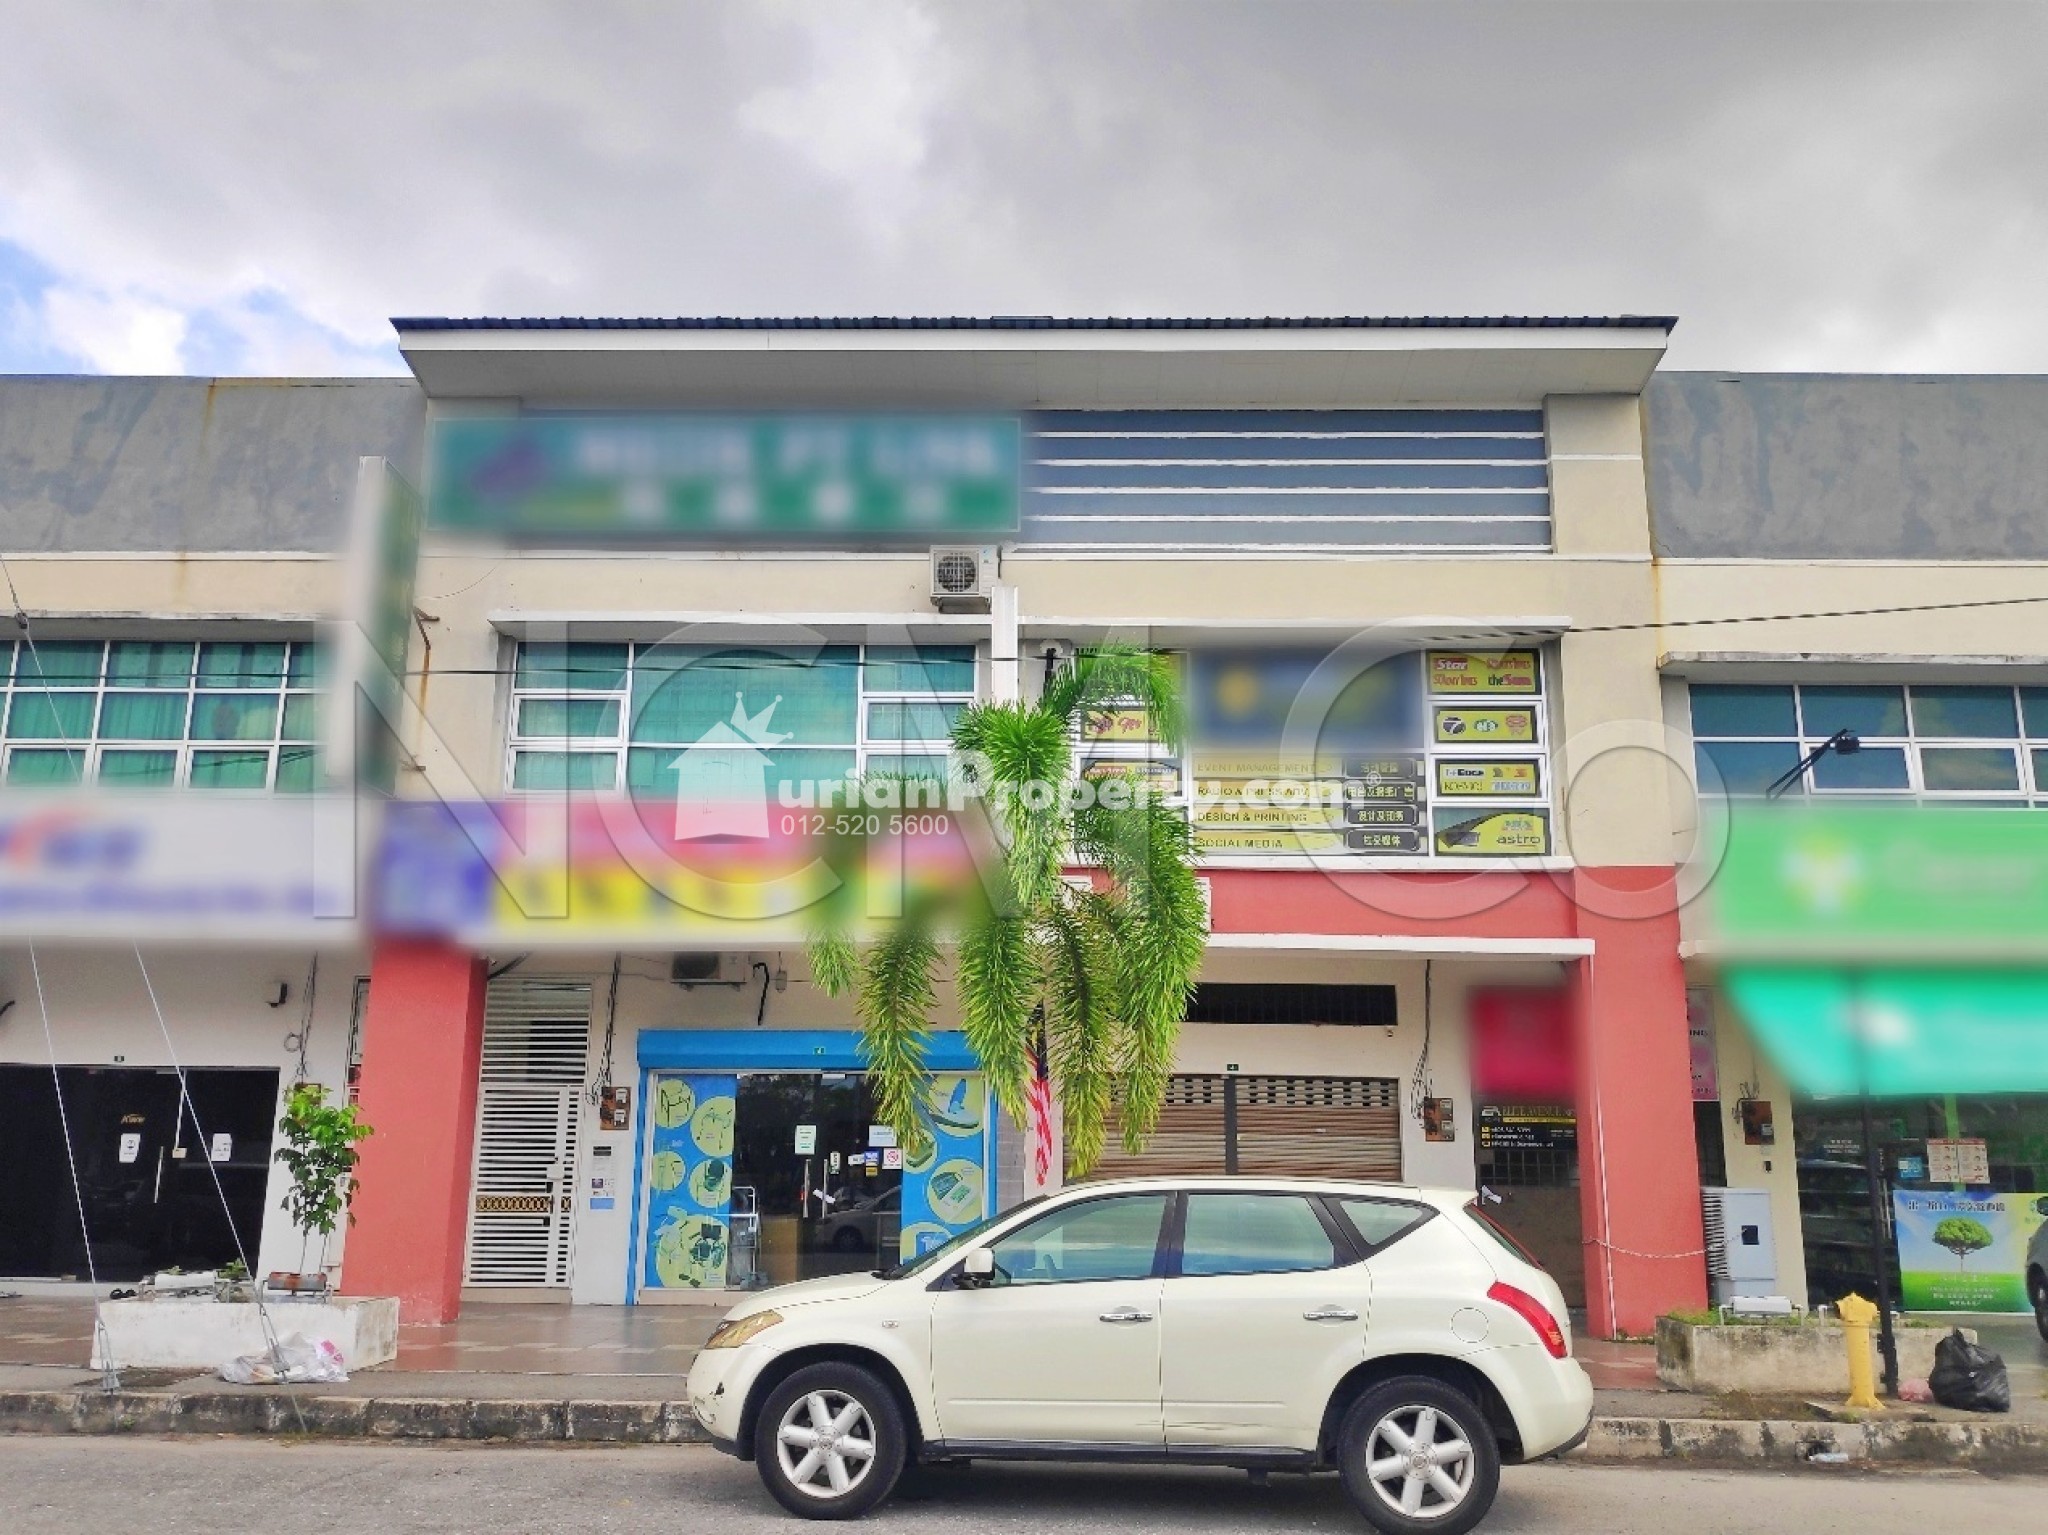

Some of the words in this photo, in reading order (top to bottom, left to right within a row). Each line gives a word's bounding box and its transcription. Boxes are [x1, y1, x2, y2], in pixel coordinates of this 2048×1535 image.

[1436, 659, 1468, 670] Star
[1197, 763, 1232, 772] EVENT
[1236, 763, 1315, 773] MANAGEMENT
[1198, 811, 1239, 821] DESIGN
[1243, 812, 1250, 821] &
[1254, 812, 1307, 821] PRINTING
[1199, 838, 1240, 848] SOCIAL
[1244, 839, 1283, 848] MEDIA
[1496, 833, 1541, 844] astro
